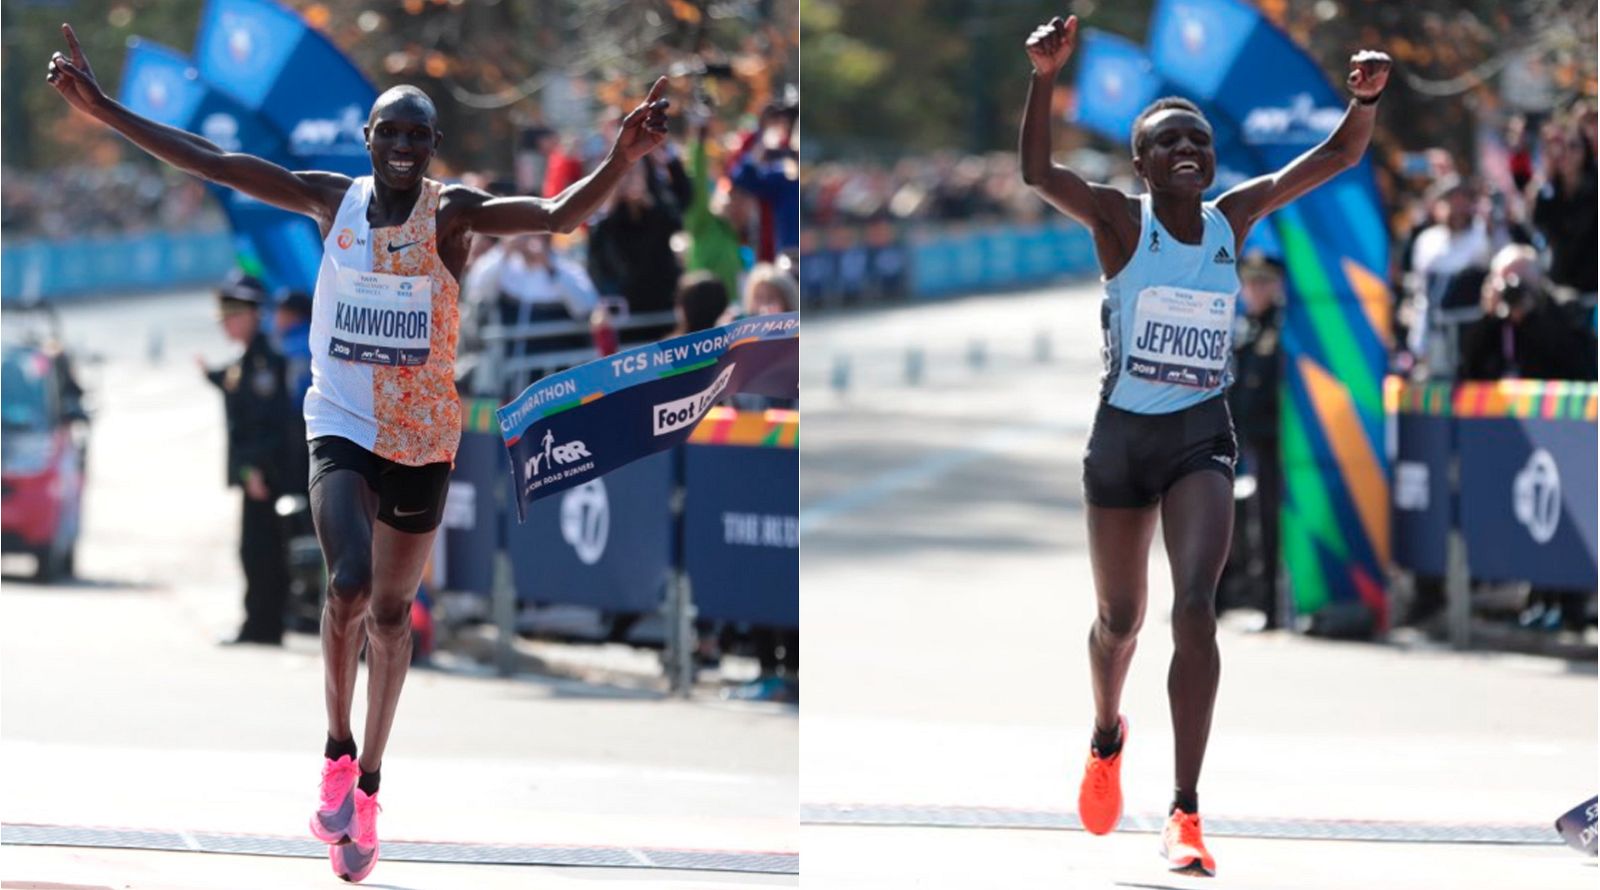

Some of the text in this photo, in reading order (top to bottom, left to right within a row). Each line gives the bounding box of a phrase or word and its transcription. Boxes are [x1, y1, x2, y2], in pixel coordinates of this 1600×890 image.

[335, 301, 428, 339] KAMWOROR
[611, 353, 648, 377] TCS
[653, 345, 689, 367] NEW
[692, 333, 729, 356] YORK
[1132, 362, 1156, 375] 2019
[521, 379, 576, 417] MARATHON
[658, 402, 695, 429] Foot
[543, 472, 563, 485] ROAD
[563, 461, 595, 478] RUNNERS
